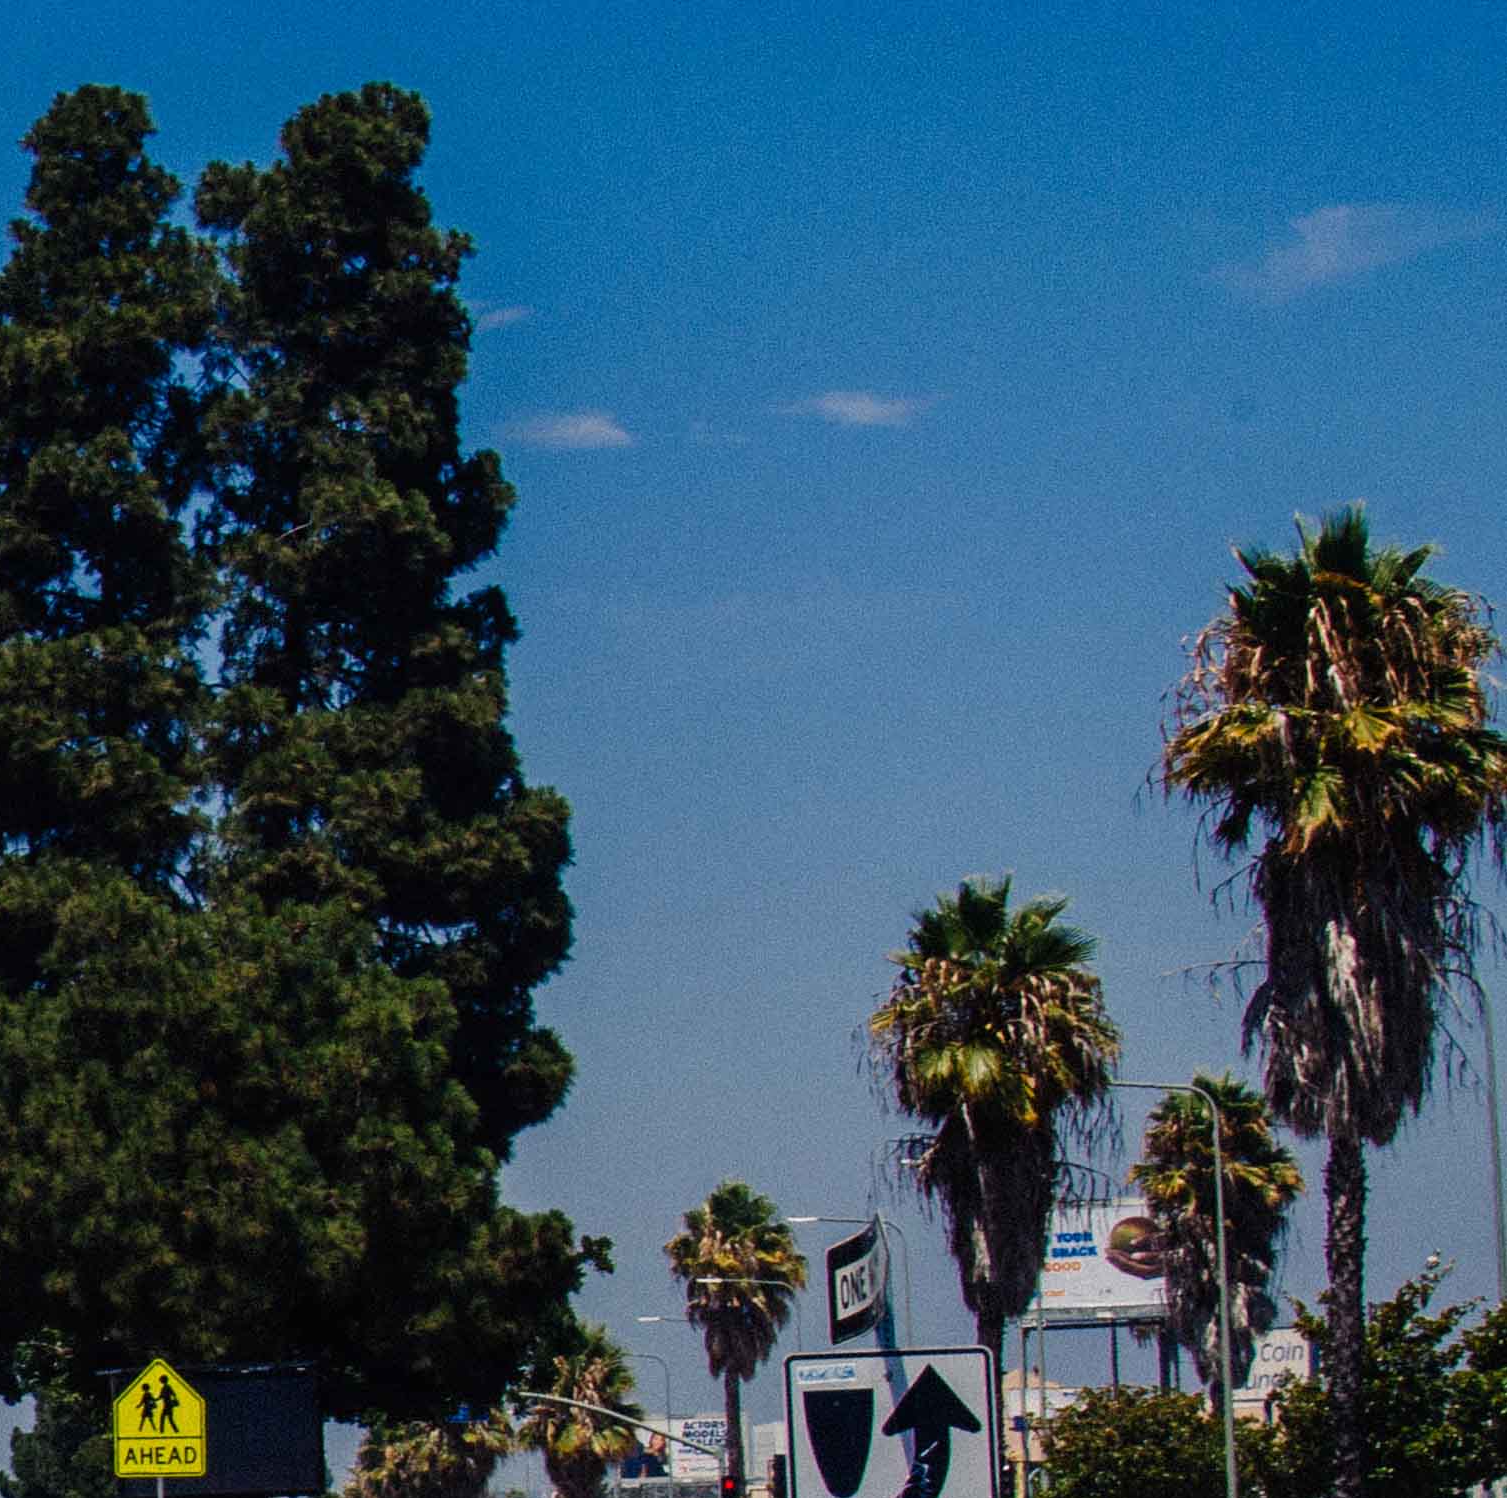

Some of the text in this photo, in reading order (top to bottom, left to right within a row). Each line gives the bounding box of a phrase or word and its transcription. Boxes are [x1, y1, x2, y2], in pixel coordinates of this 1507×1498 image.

[841, 1266, 866, 1309] ONE
[1261, 1342, 1304, 1362] Coin
[124, 1446, 198, 1466] AHEAD
